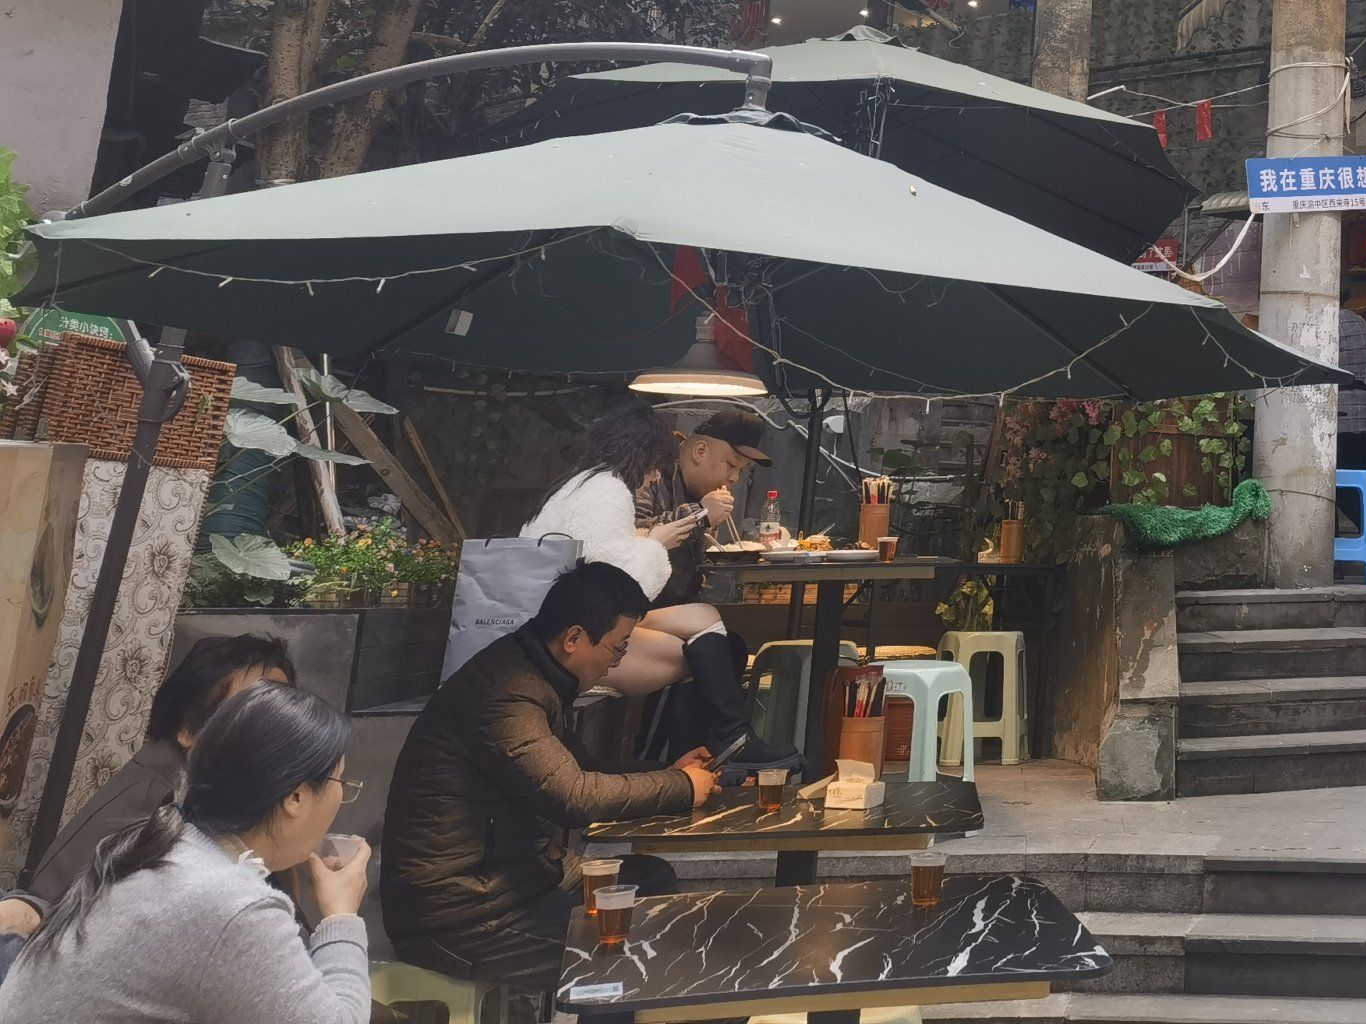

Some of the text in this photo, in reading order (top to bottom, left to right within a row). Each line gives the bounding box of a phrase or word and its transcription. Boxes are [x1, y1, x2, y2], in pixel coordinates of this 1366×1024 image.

[1261, 202, 1270, 211] 东
[1292, 198, 1366, 210] 重庆渝中区西来寺15号
[474, 618, 515, 626] BALENCIAGA
